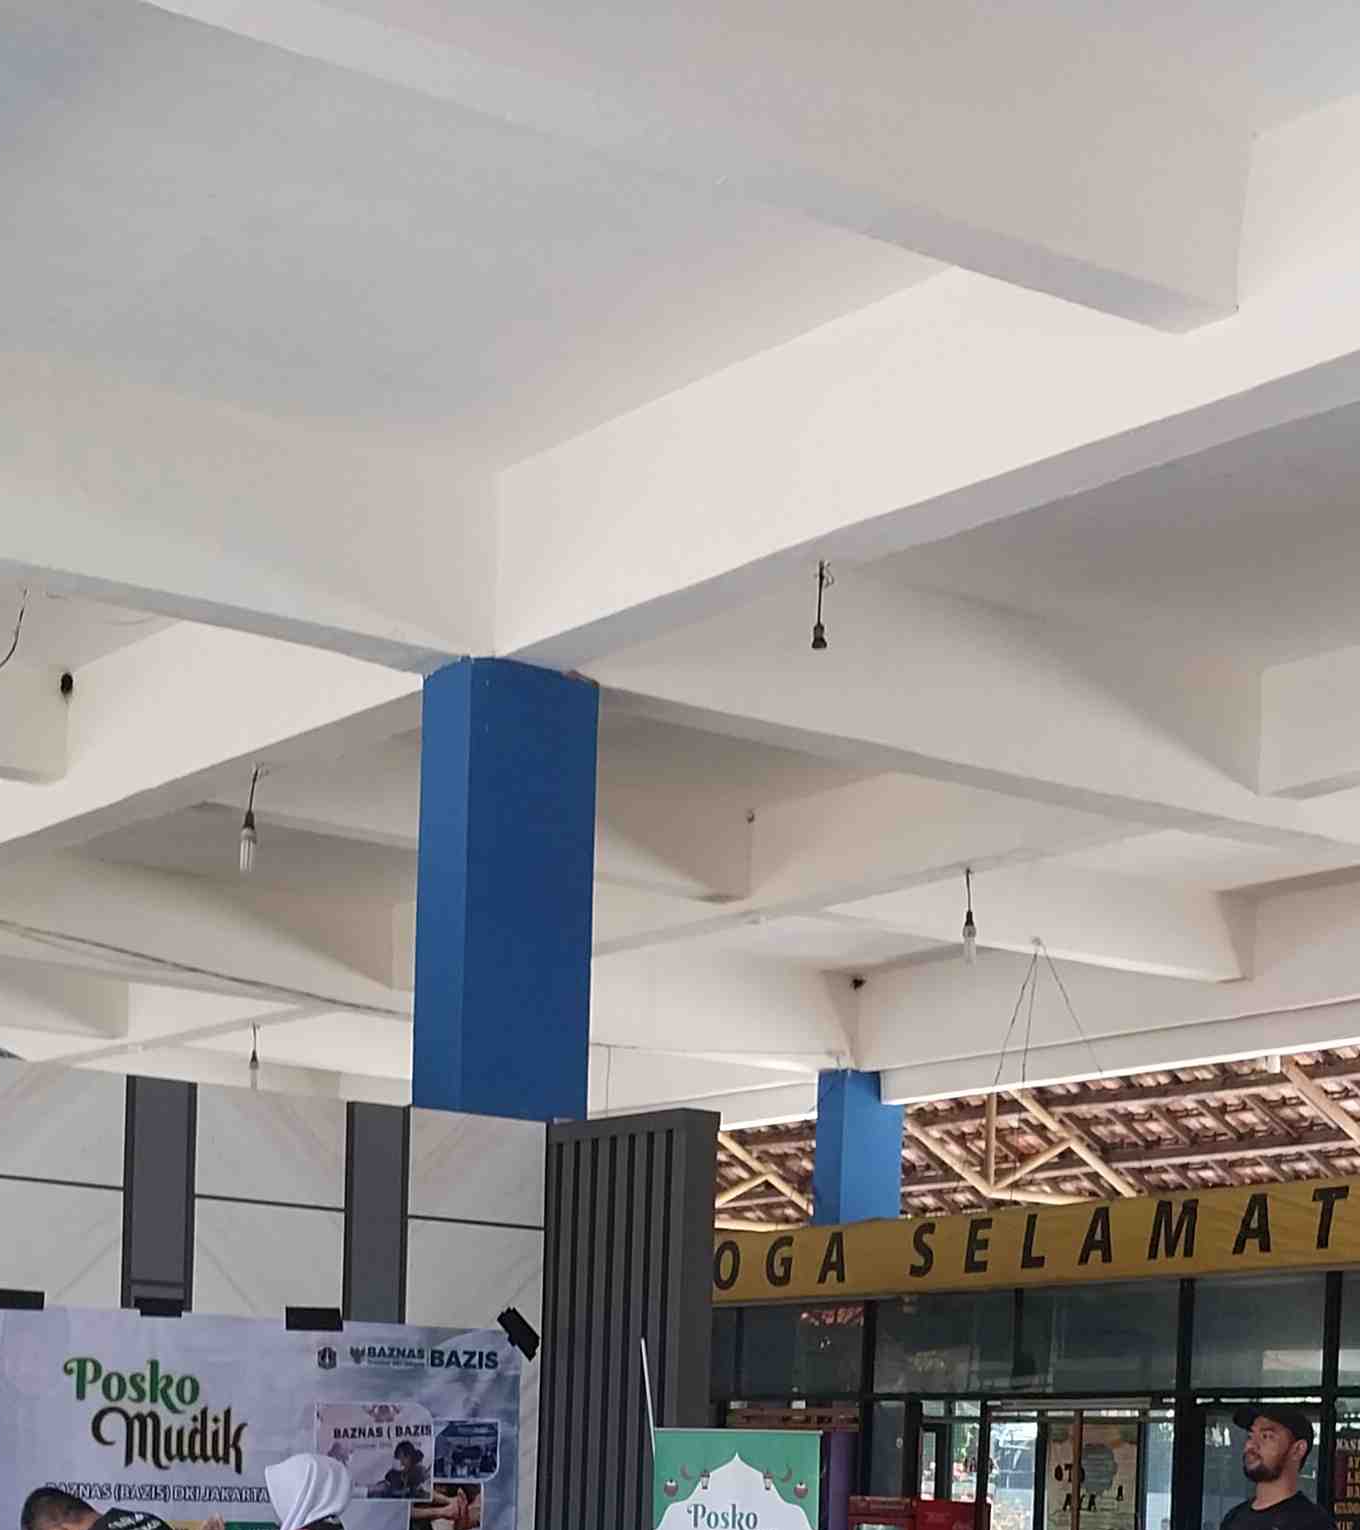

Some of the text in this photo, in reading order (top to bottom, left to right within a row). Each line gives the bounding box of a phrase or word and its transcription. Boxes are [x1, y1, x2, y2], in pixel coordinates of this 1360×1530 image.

[909, 1185, 1350, 1279] SELAMAT
[63, 1357, 200, 1414] Posko
[430, 1350, 500, 1369] BAZIS
[92, 1406, 249, 1475] Mudik
[333, 1425, 384, 1439] BAZNAS
